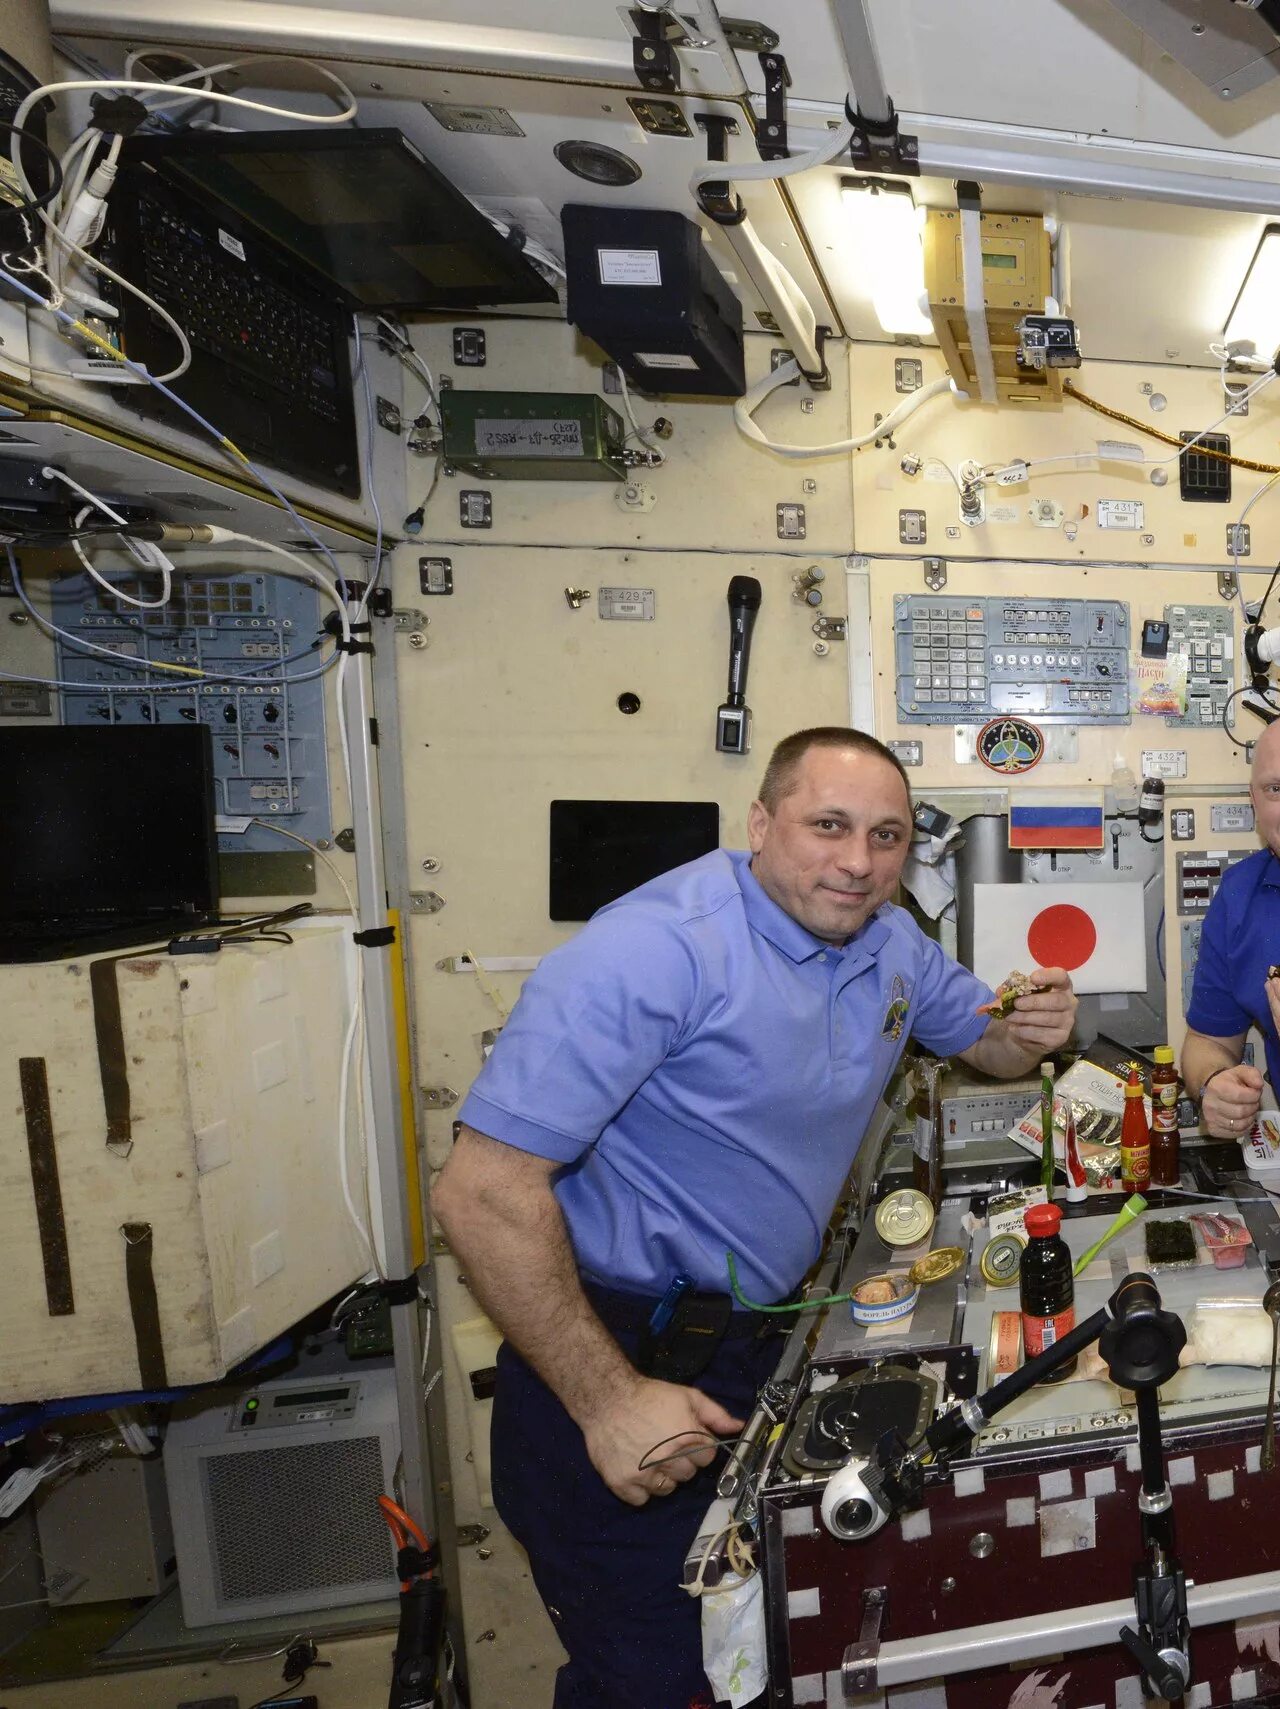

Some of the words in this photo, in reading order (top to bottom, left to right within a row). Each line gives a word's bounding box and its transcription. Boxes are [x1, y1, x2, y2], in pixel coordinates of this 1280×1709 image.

[1114, 503, 1131, 511] 431
[618, 591, 640, 601] 429
[1158, 753, 1175, 761] 432
[1227, 807, 1243, 815] 434
[1255, 1148, 1264, 1159] LA
[863, 1310, 890, 1318] ФОРЕЛЬ
